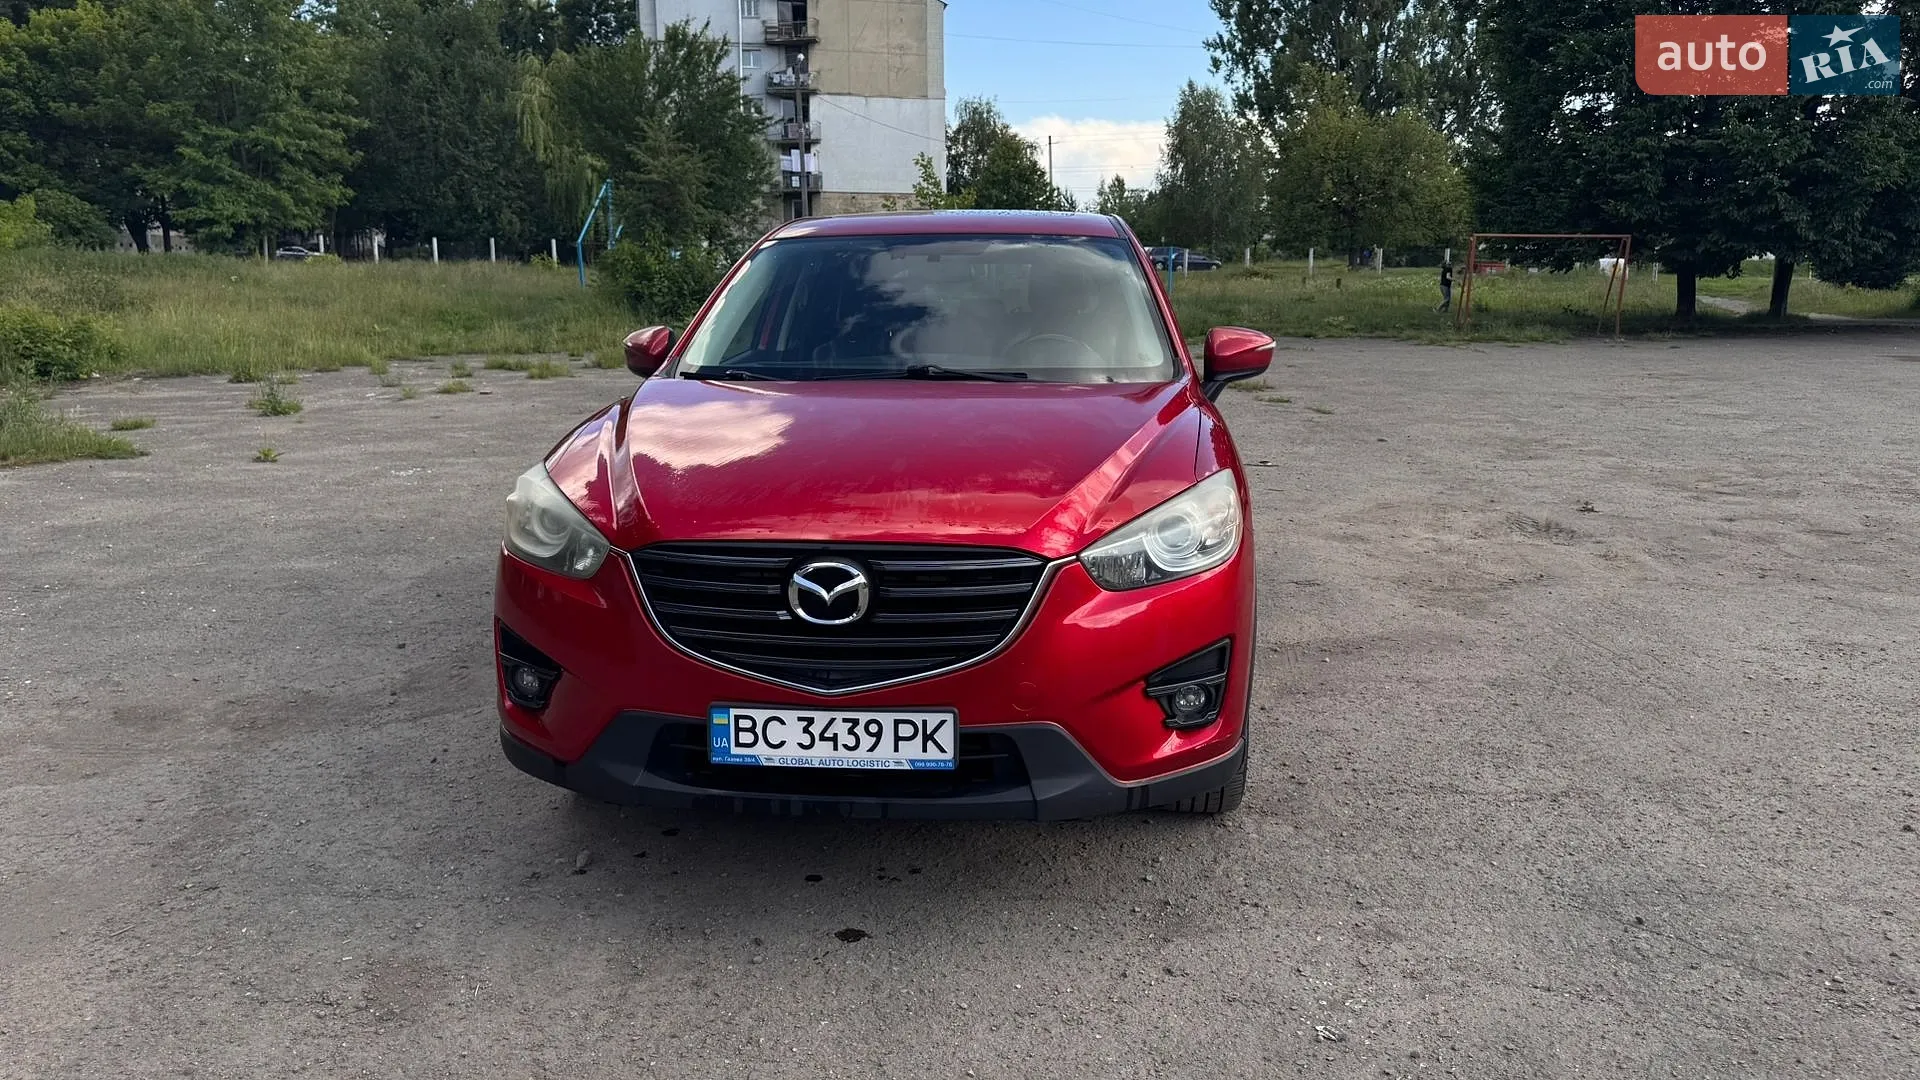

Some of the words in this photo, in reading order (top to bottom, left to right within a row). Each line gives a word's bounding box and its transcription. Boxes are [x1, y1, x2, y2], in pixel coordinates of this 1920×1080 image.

[733, 714, 787, 751] BC
[796, 716, 884, 753] 3439
[893, 719, 948, 754] PK
[713, 737, 729, 749] UA
[778, 757, 815, 766] GLOBAL
[818, 759, 844, 767] AUTO
[846, 759, 890, 768] LOGISTIC
